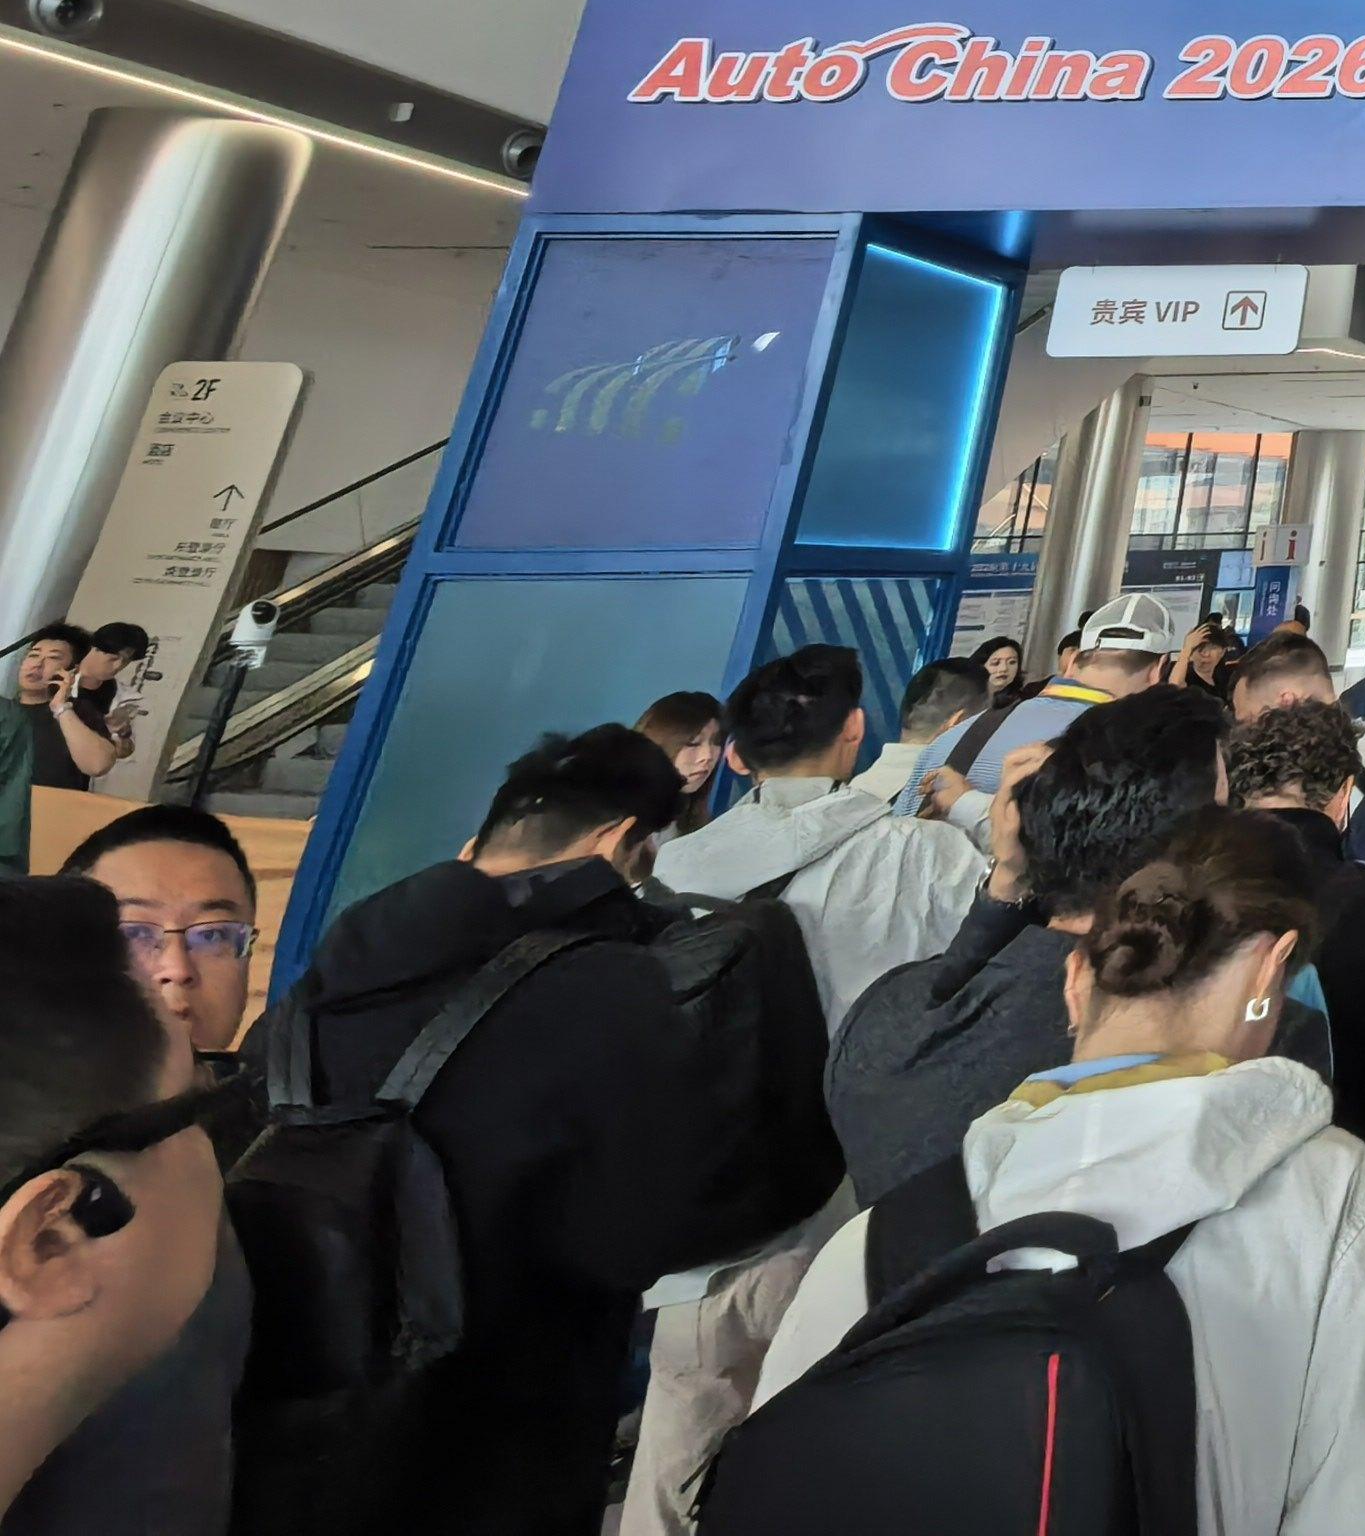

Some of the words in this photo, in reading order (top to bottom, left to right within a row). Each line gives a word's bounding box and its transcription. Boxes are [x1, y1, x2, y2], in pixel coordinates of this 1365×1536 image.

[627, 38, 863, 104] Auto
[884, 22, 1154, 104] China
[1089, 298, 1147, 326] 贵宾
[1155, 299, 1201, 324] VIP
[191, 378, 221, 401] 2F
